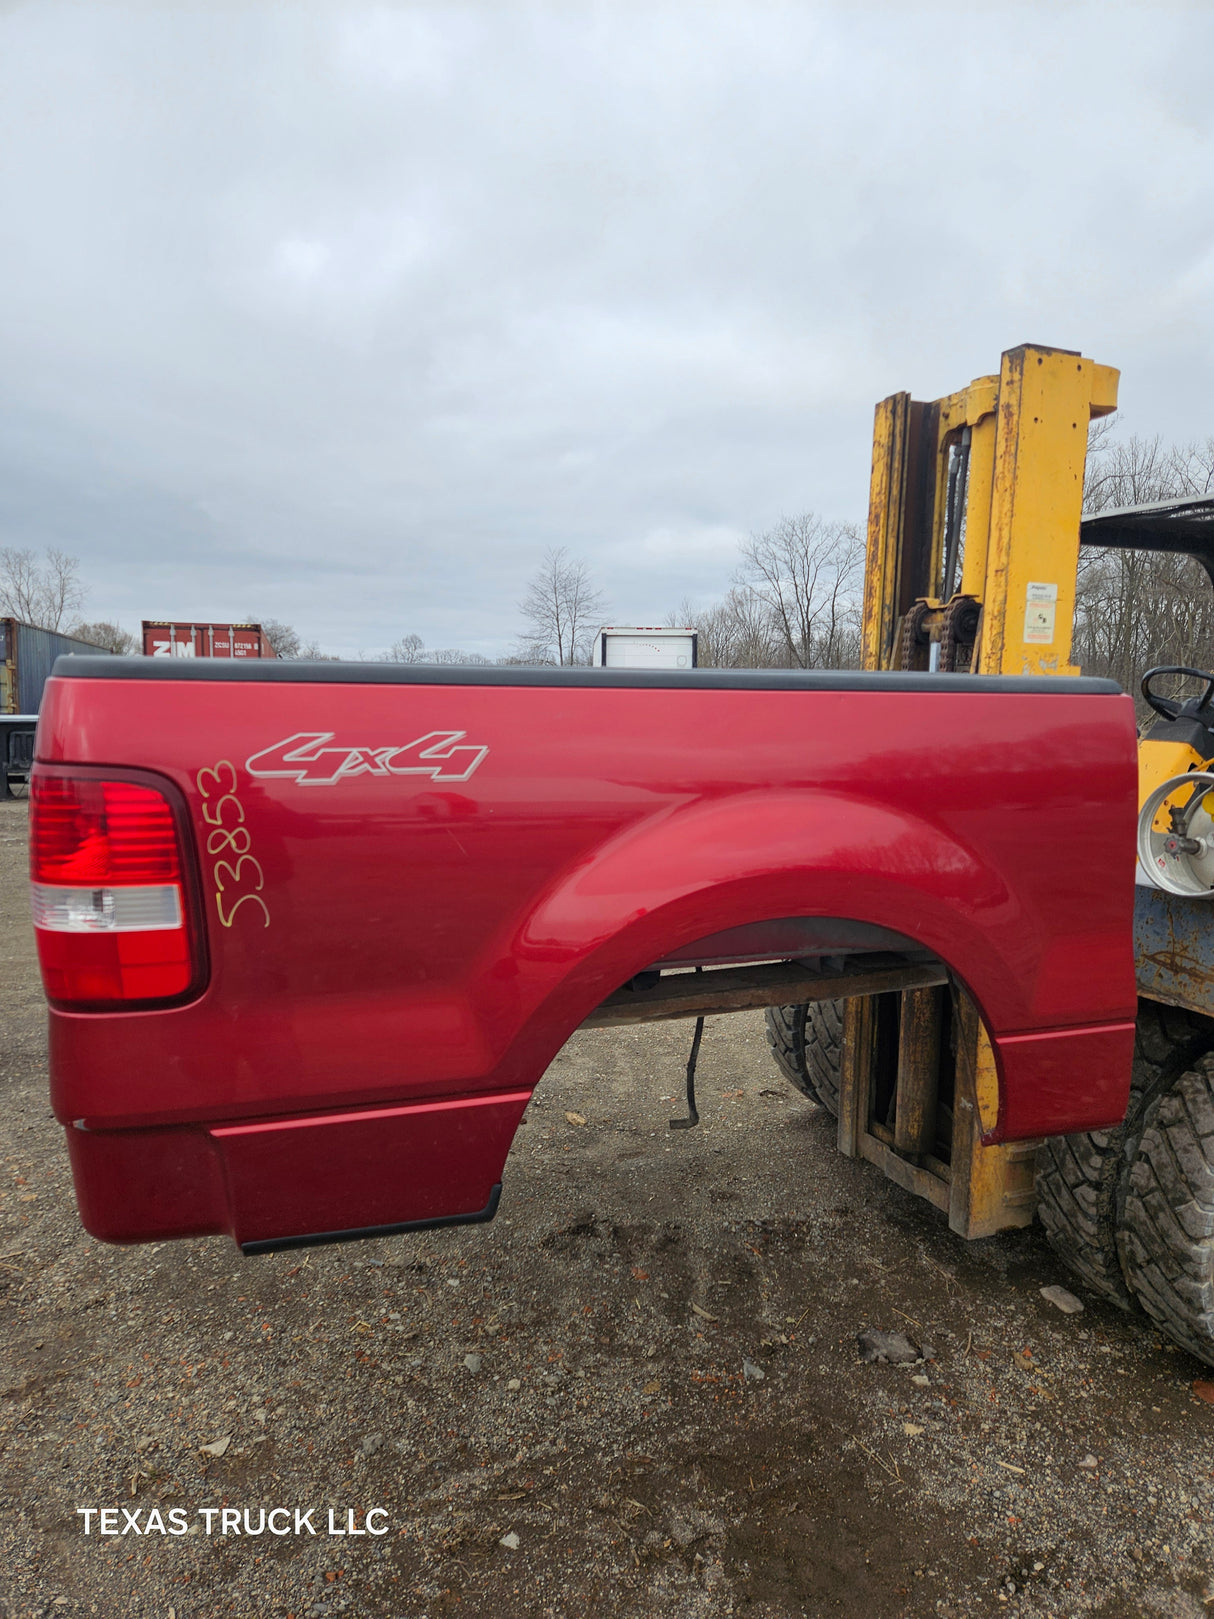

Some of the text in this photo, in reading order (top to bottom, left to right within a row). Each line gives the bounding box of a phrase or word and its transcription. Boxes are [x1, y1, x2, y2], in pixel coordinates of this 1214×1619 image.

[153, 641, 195, 658] ZIM
[245, 730, 490, 786] 4x4
[196, 760, 271, 928] 53853
